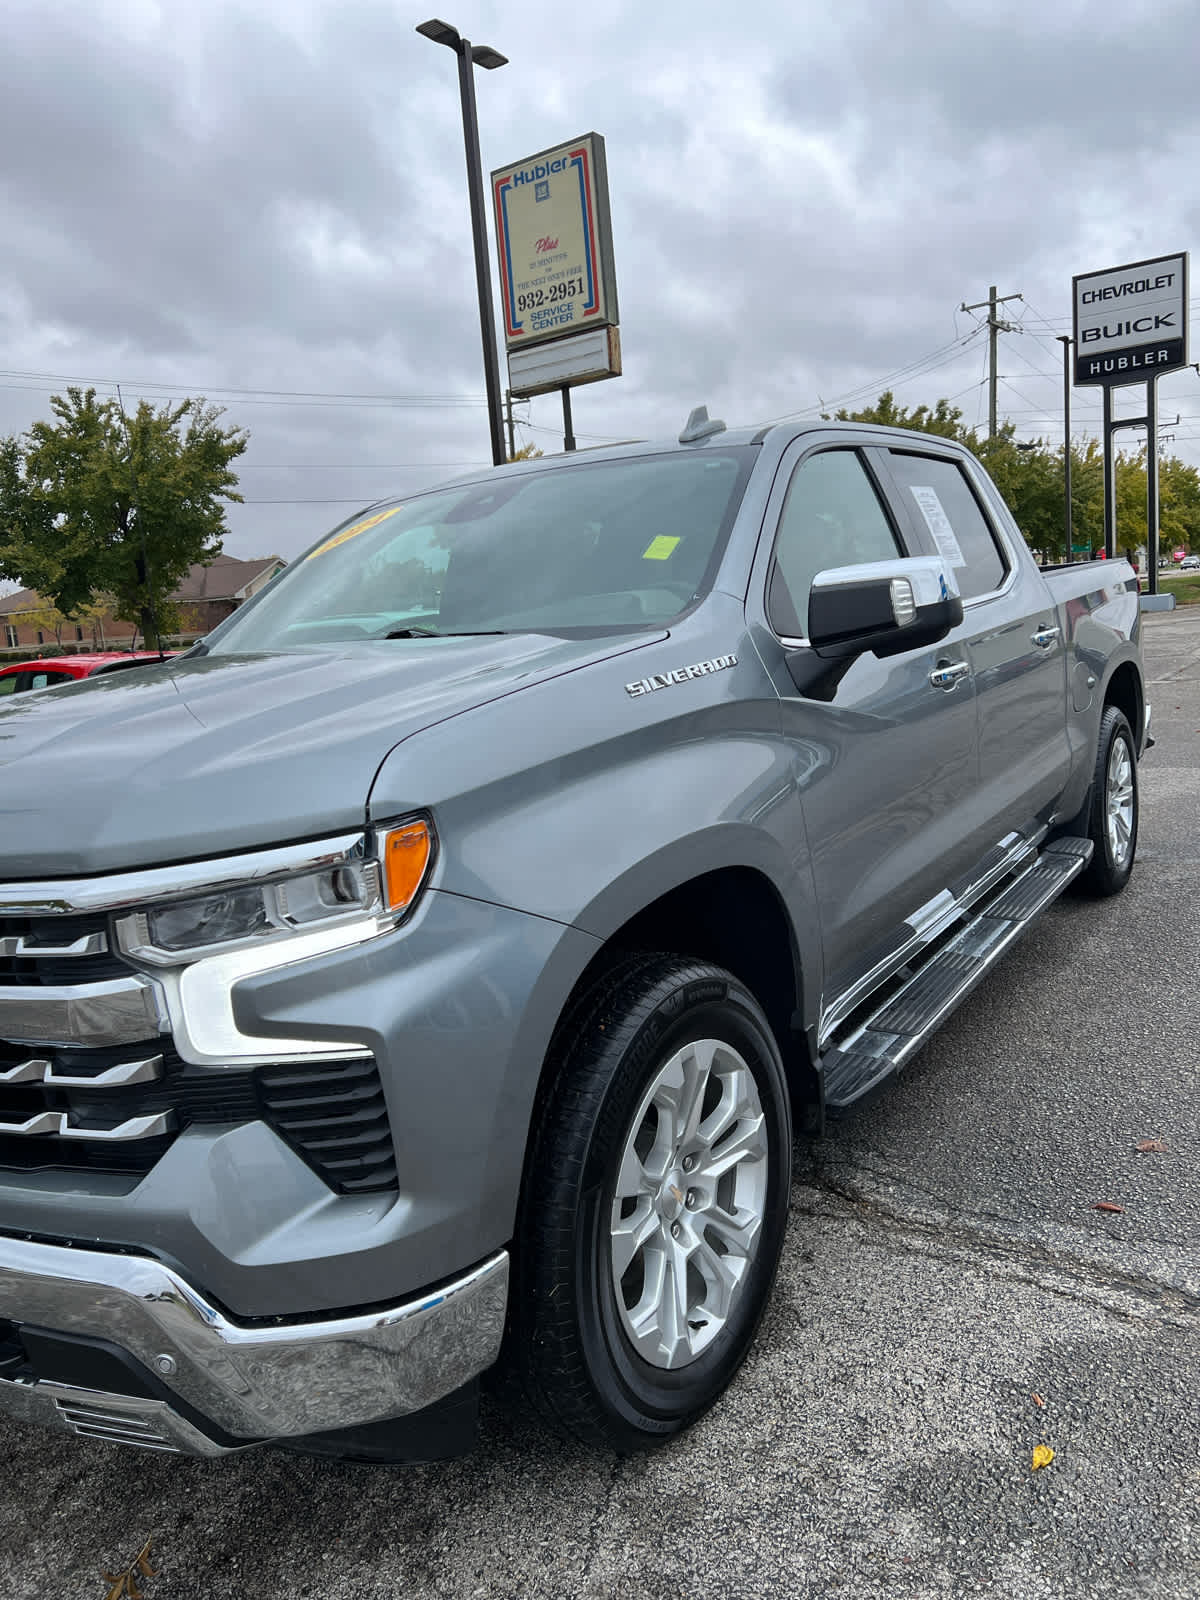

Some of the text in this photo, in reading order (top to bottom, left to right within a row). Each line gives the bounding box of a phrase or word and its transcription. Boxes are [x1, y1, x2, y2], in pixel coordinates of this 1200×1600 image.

[513, 157, 568, 188] Hubler
[535, 235, 559, 254] Plus
[518, 277, 584, 311] 932-2951
[1081, 273, 1175, 305] CHEVROLET
[530, 302, 574, 322] SERVICE
[532, 312, 574, 331] CENTER
[1081, 312, 1177, 343] BUICK
[1090, 350, 1168, 374] HUBLER
[625, 654, 738, 697] SILVERADO
